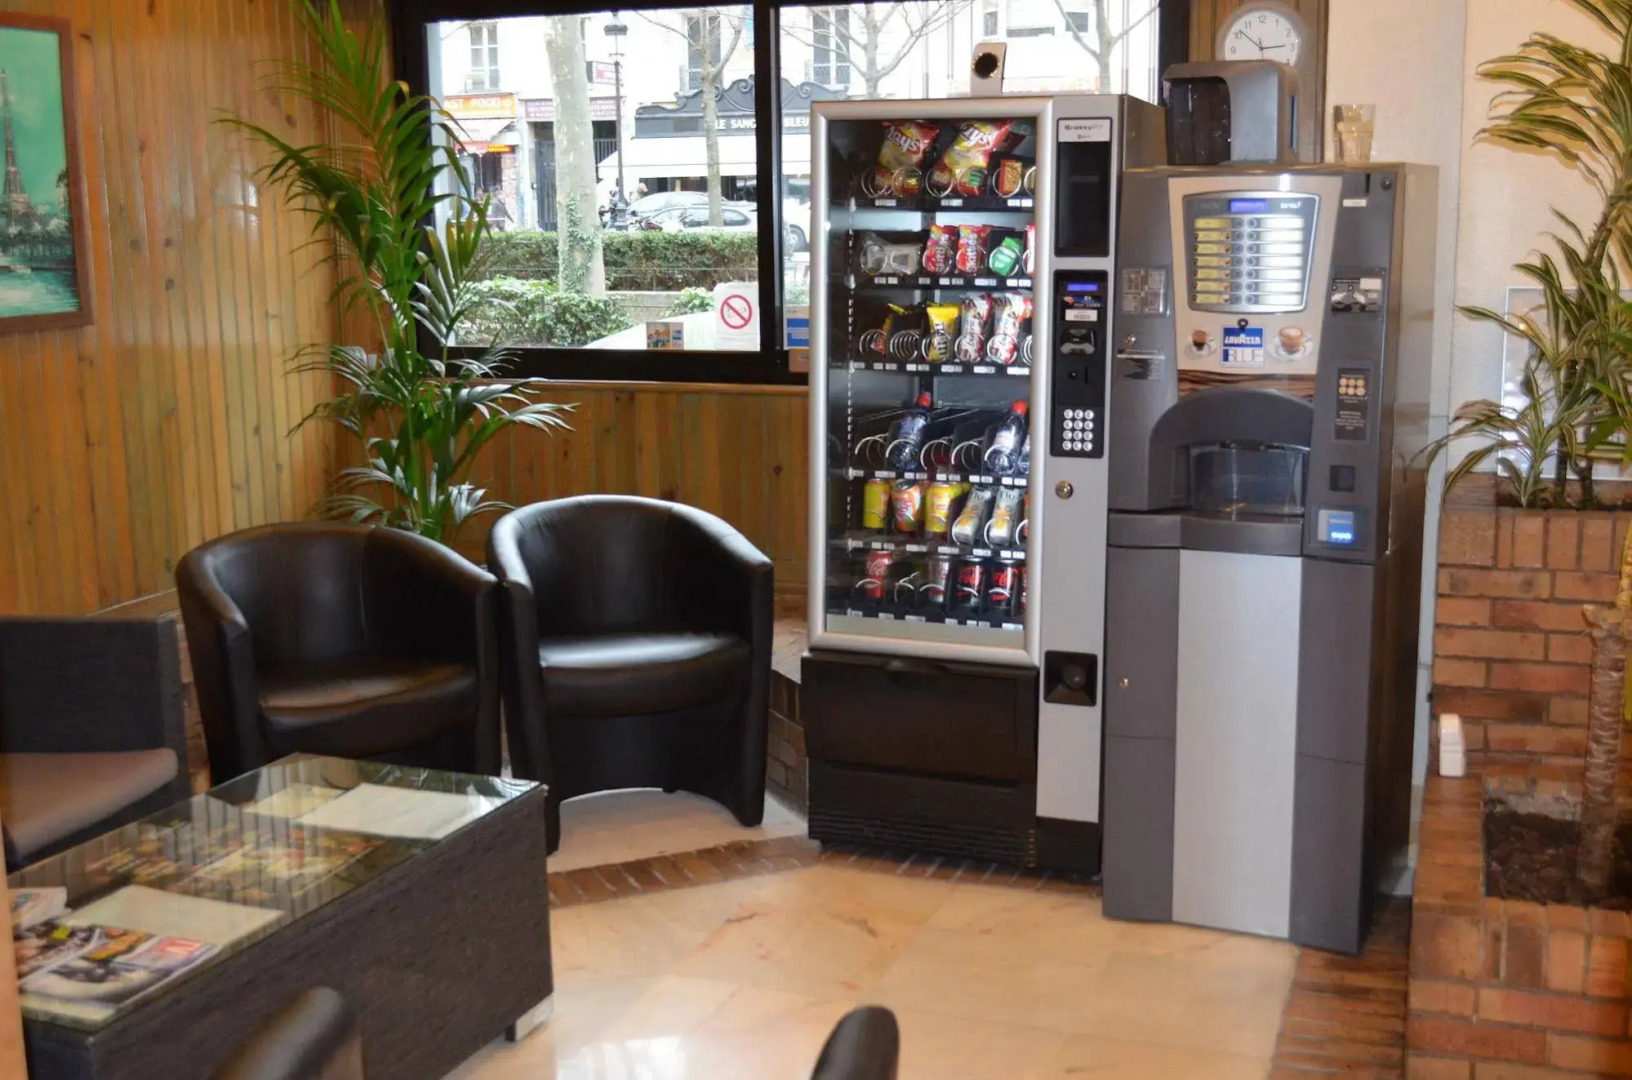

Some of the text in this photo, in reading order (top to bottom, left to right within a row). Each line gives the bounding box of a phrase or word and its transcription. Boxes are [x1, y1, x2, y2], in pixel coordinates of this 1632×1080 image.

[1258, 15, 1267, 24] 12
[1244, 21, 1252, 29] 11
[1234, 32, 1242, 40] 10
[1285, 29, 1292, 37] 2
[1230, 46, 1236, 54] 9
[1289, 43, 1295, 52] 3
[444, 98, 463, 110] AST
[715, 116, 809, 130] LE SANG BLEU
[965, 319, 975, 347] bueno
[1224, 333, 1261, 344] LAVAZZA
